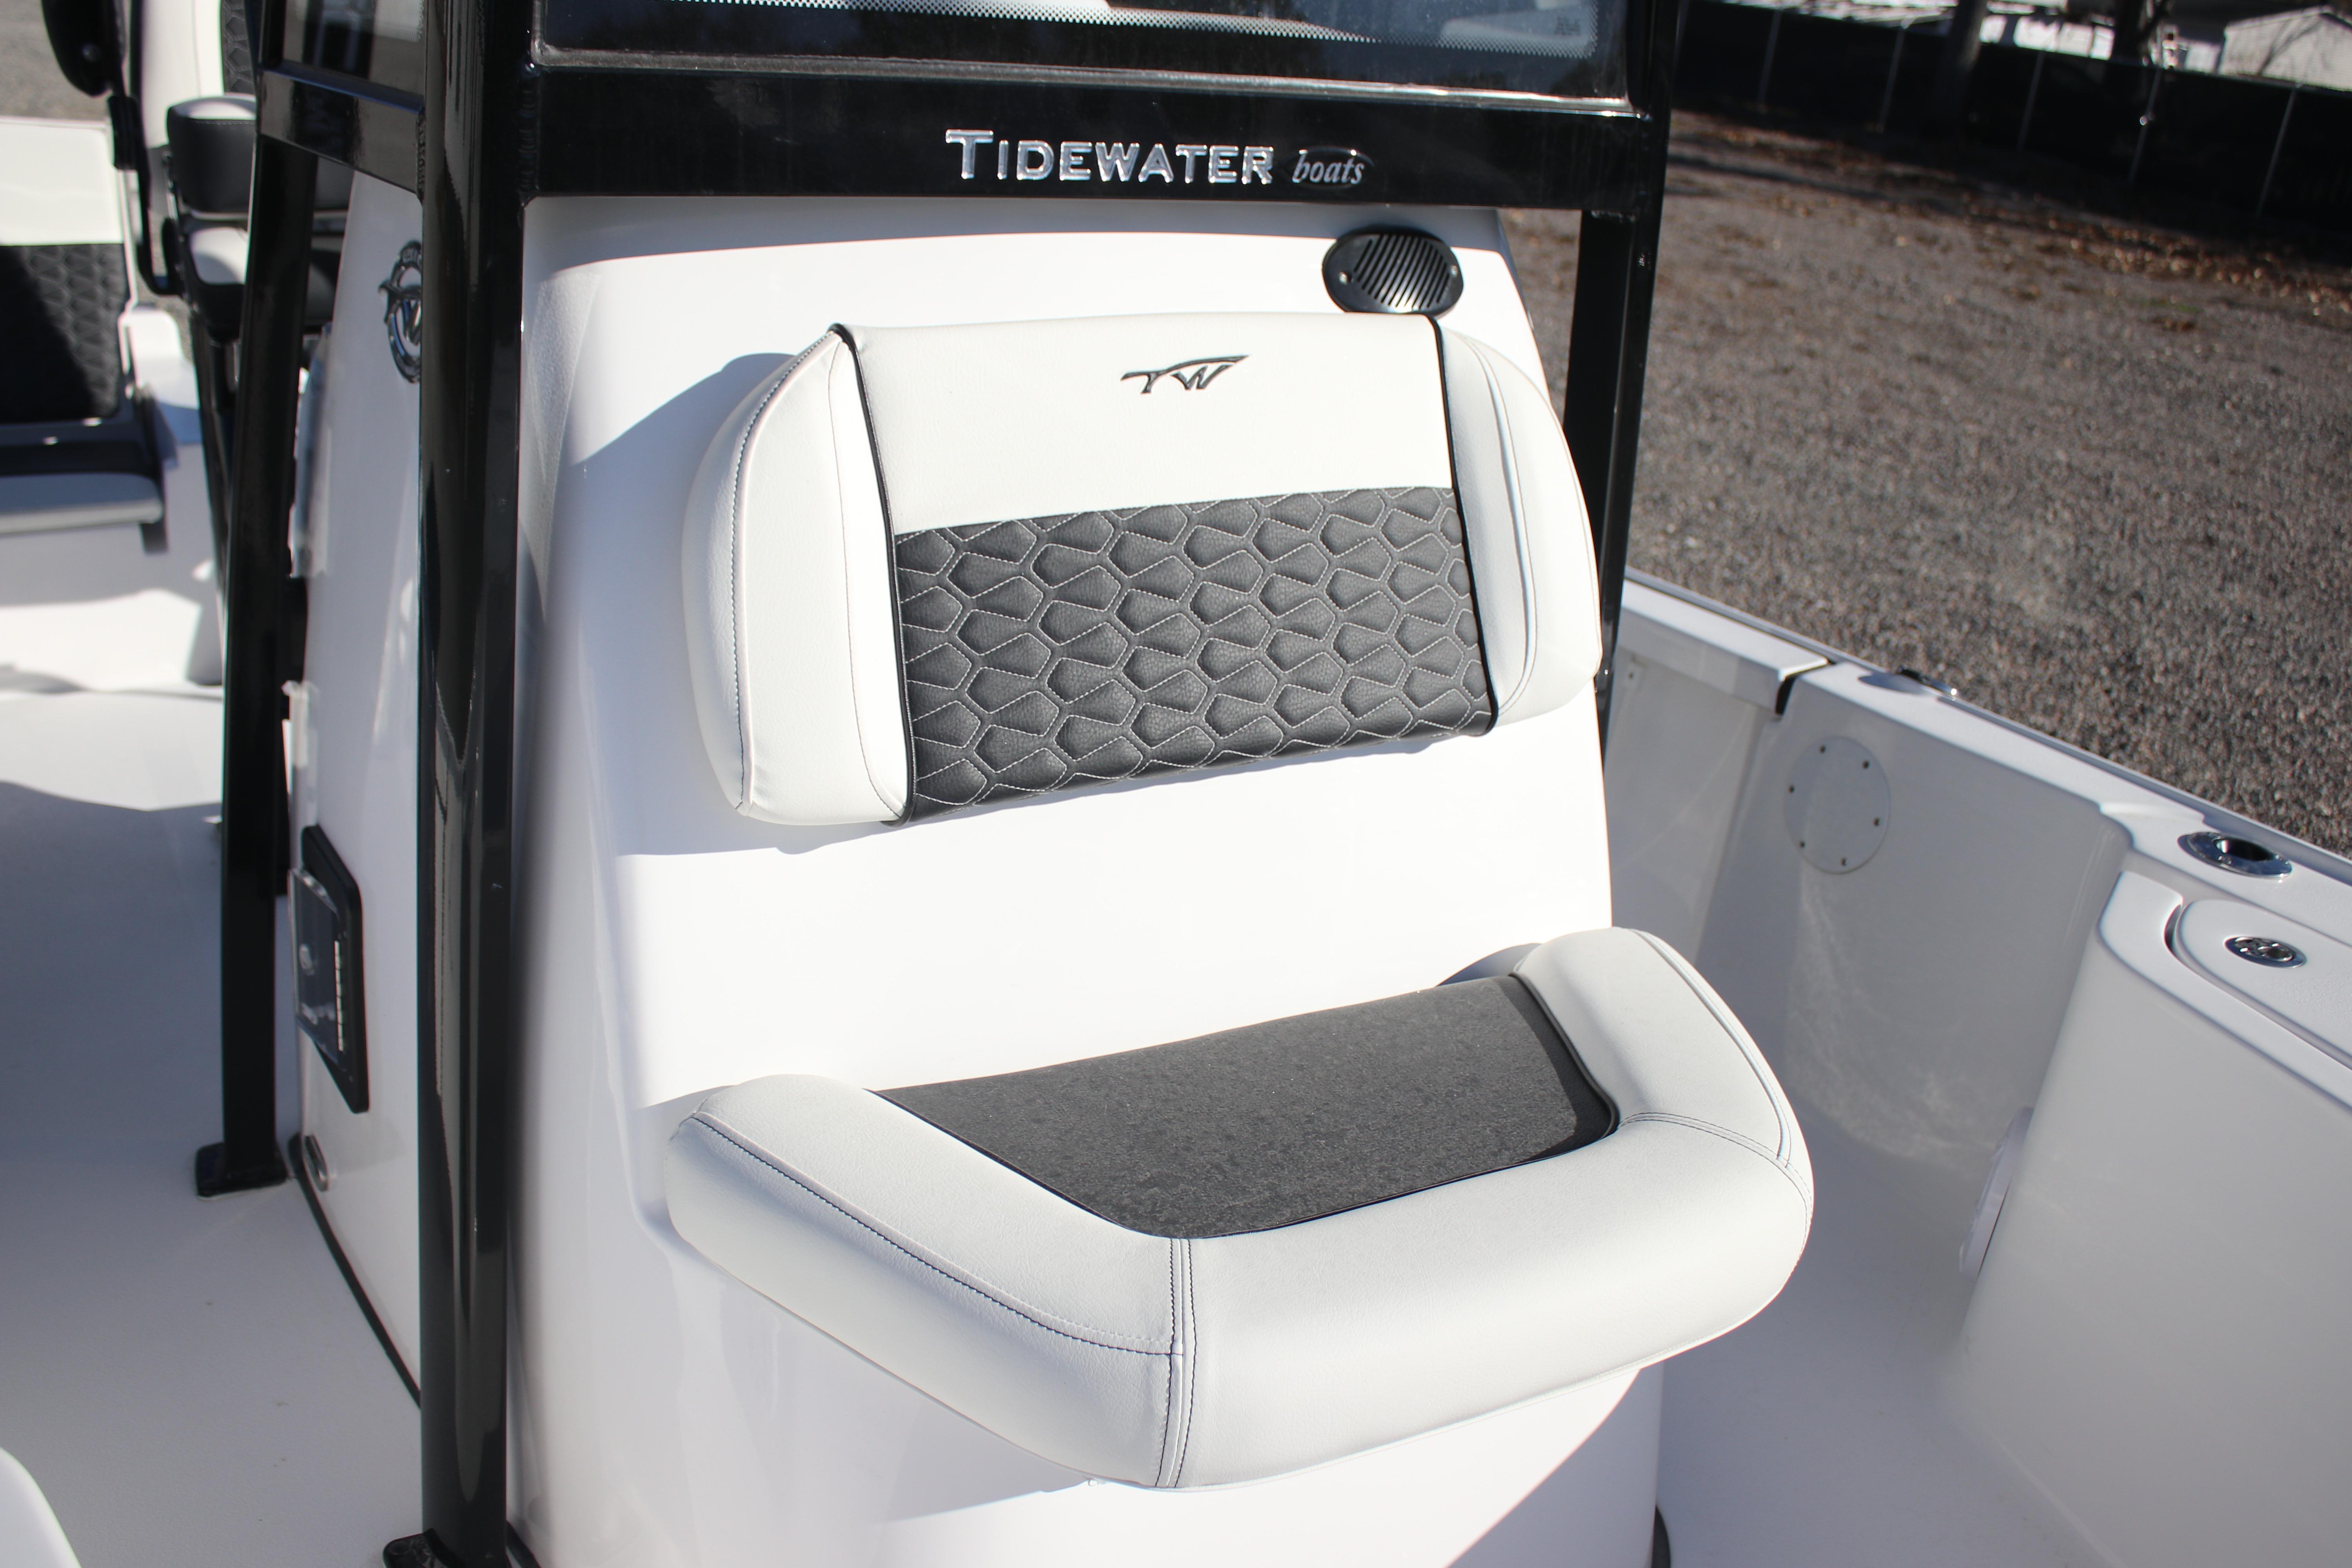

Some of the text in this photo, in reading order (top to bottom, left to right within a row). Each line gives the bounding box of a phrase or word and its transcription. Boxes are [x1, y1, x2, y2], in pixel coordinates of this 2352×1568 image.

[944, 128, 1366, 185] TIDEWATER boats
[1120, 354, 1250, 394] TW
